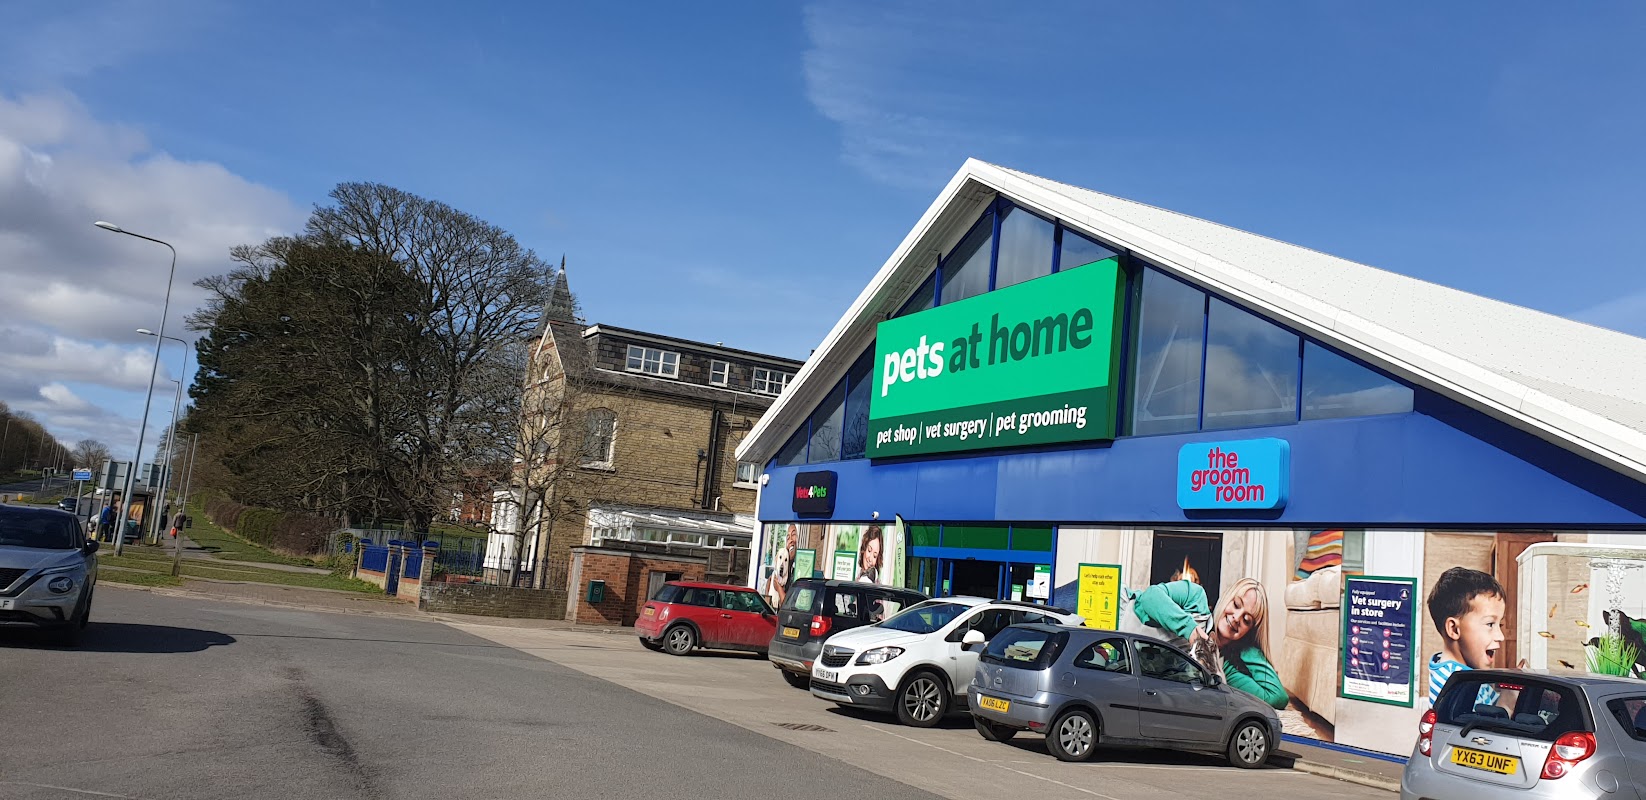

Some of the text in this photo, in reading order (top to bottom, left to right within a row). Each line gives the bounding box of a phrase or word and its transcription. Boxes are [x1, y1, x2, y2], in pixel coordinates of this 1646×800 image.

[881, 307, 1093, 397] pets at home
[876, 404, 1087, 448] pet shop vet surgery pet grooming
[1208, 447, 1238, 469] the
[1191, 467, 1250, 491] groom
[796, 485, 827, 499] Vets4Pets
[1215, 484, 1264, 502] room
[1351, 606, 1383, 617] in store
[1352, 595, 1401, 610] Vet surgery
[1456, 750, 1484, 768] YX63
[1486, 758, 1511, 770] UNF
